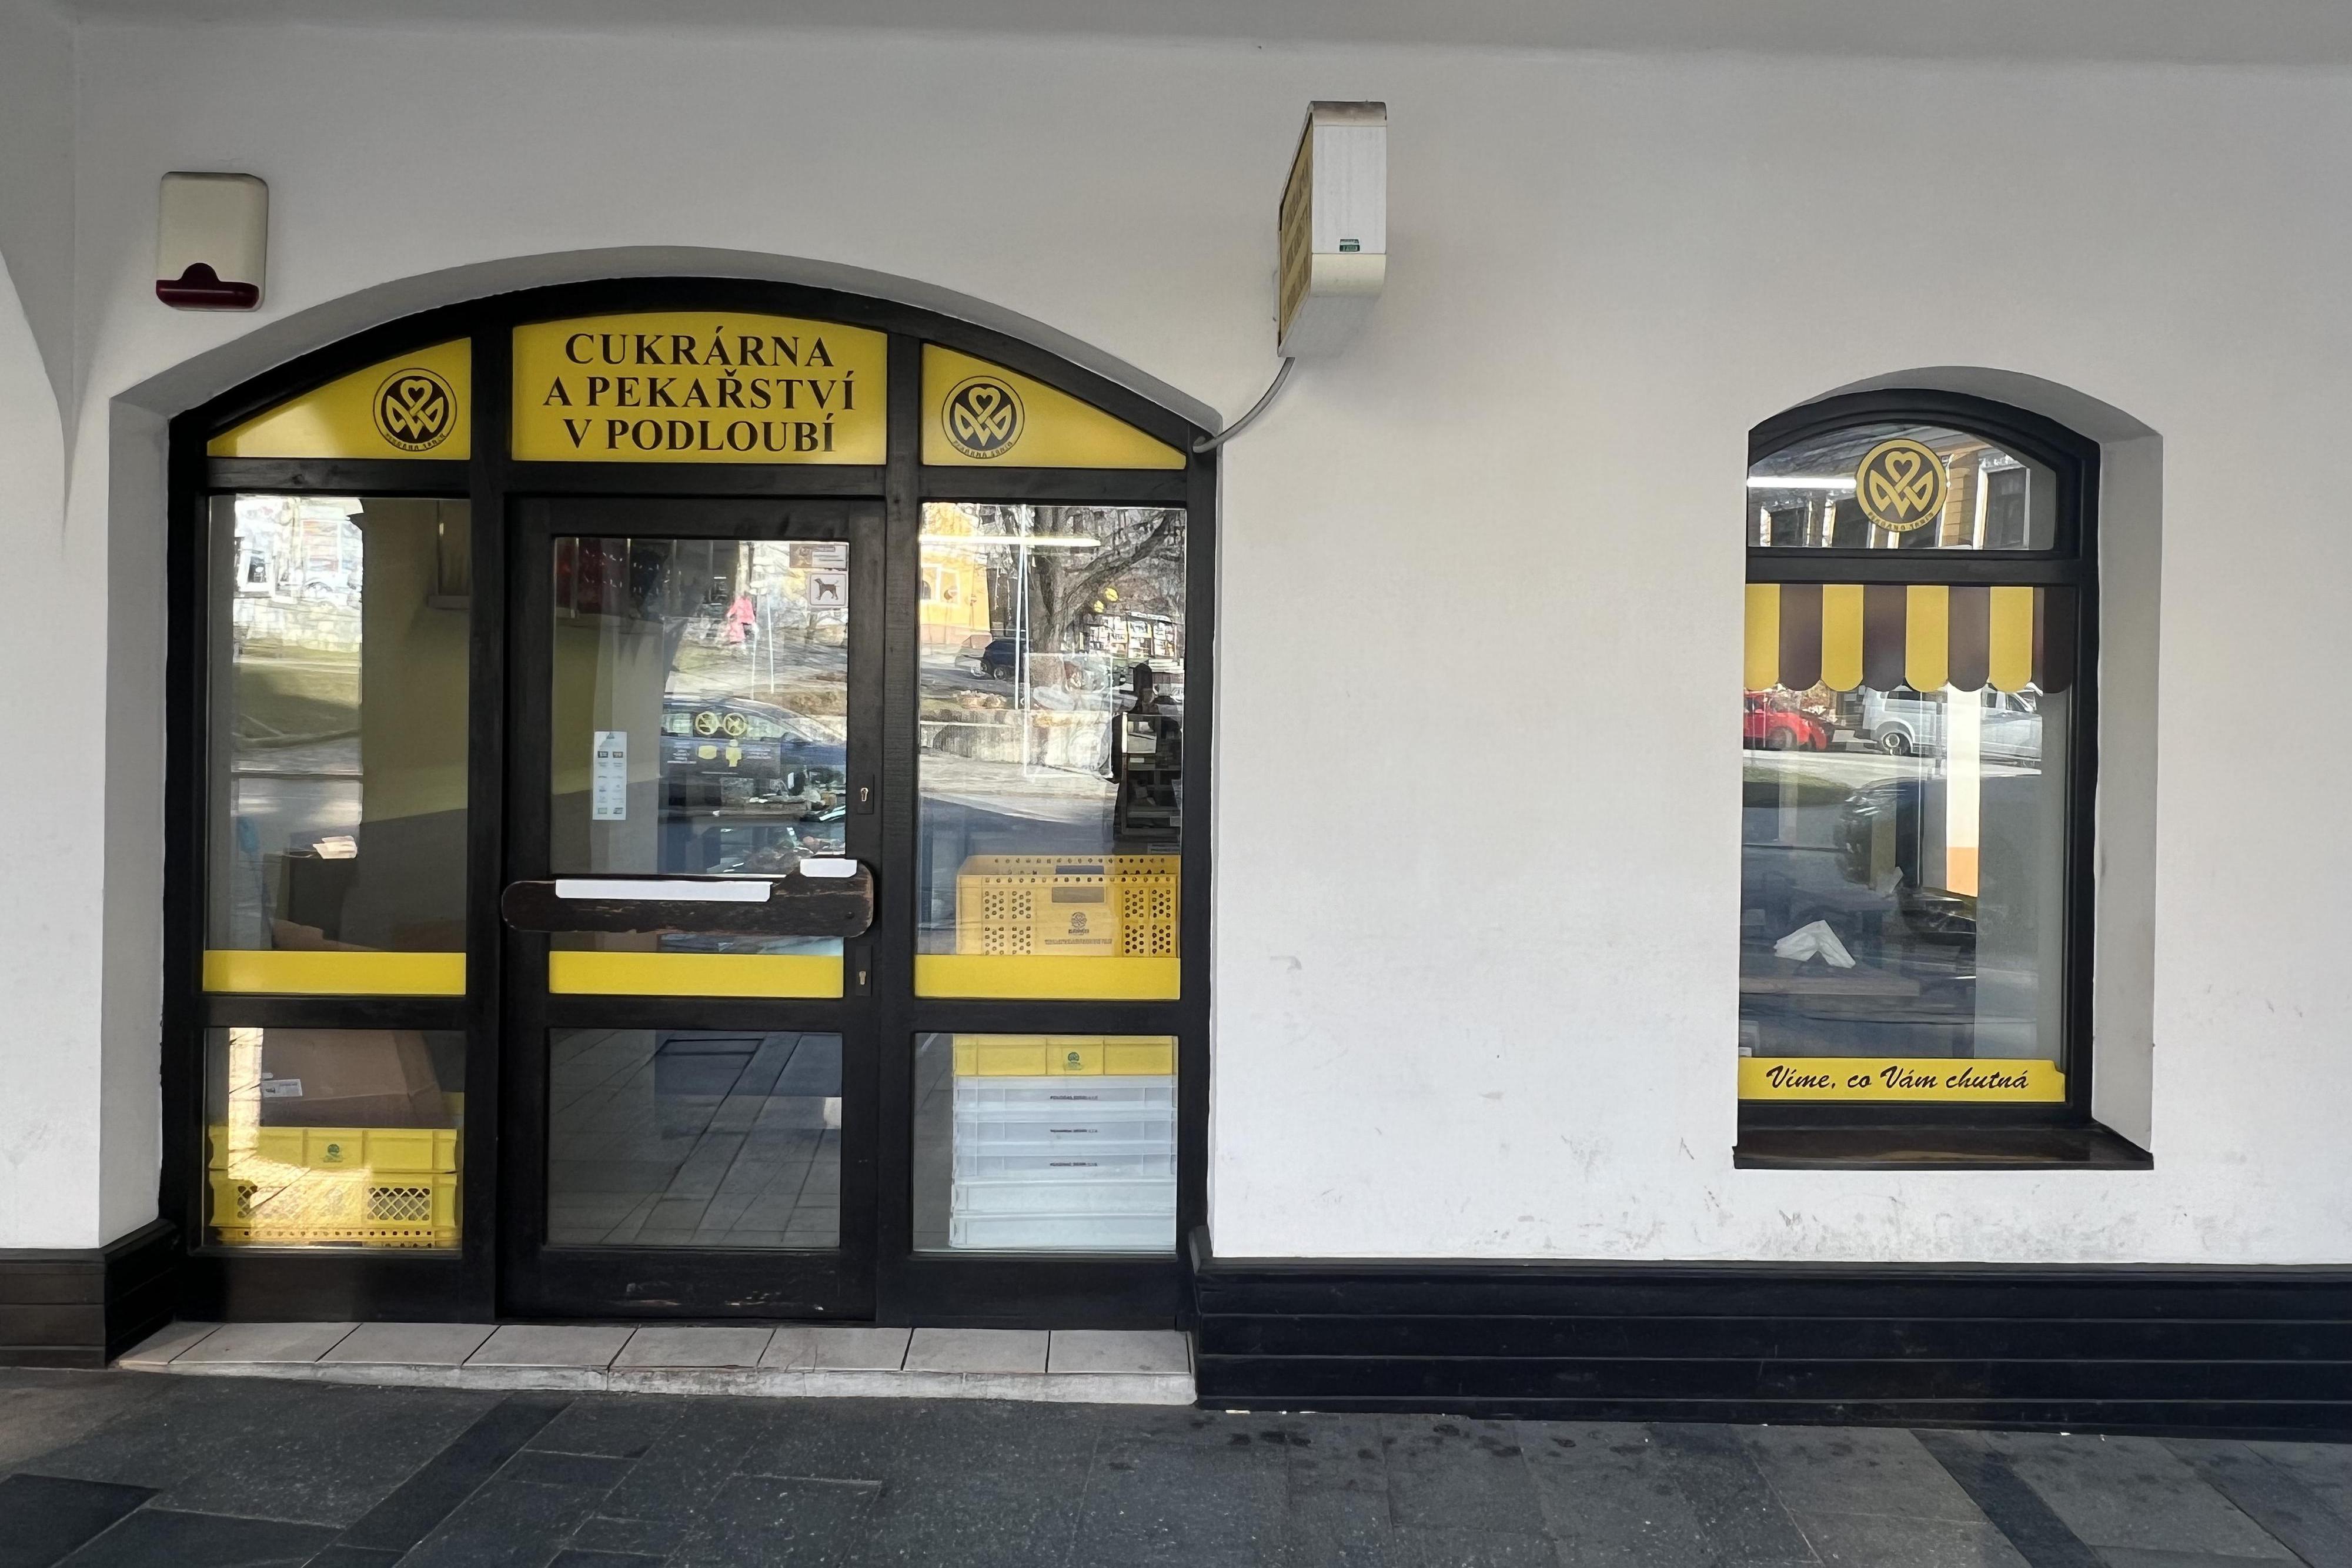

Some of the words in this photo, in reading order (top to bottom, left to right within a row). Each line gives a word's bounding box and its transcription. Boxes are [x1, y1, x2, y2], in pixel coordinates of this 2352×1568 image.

[565, 326, 834, 367] CUKRÁRNA
[543, 376, 572, 406] A
[587, 368, 855, 410] PEKAŘSTVÍ
[563, 419, 592, 449] V
[606, 413, 836, 452] PODLOUBÍ
[1766, 1065, 1836, 1090] Víme,
[1847, 1075, 1872, 1089] co
[1879, 1065, 1938, 1089] Vám
[1945, 1066, 2029, 1089] chutná
